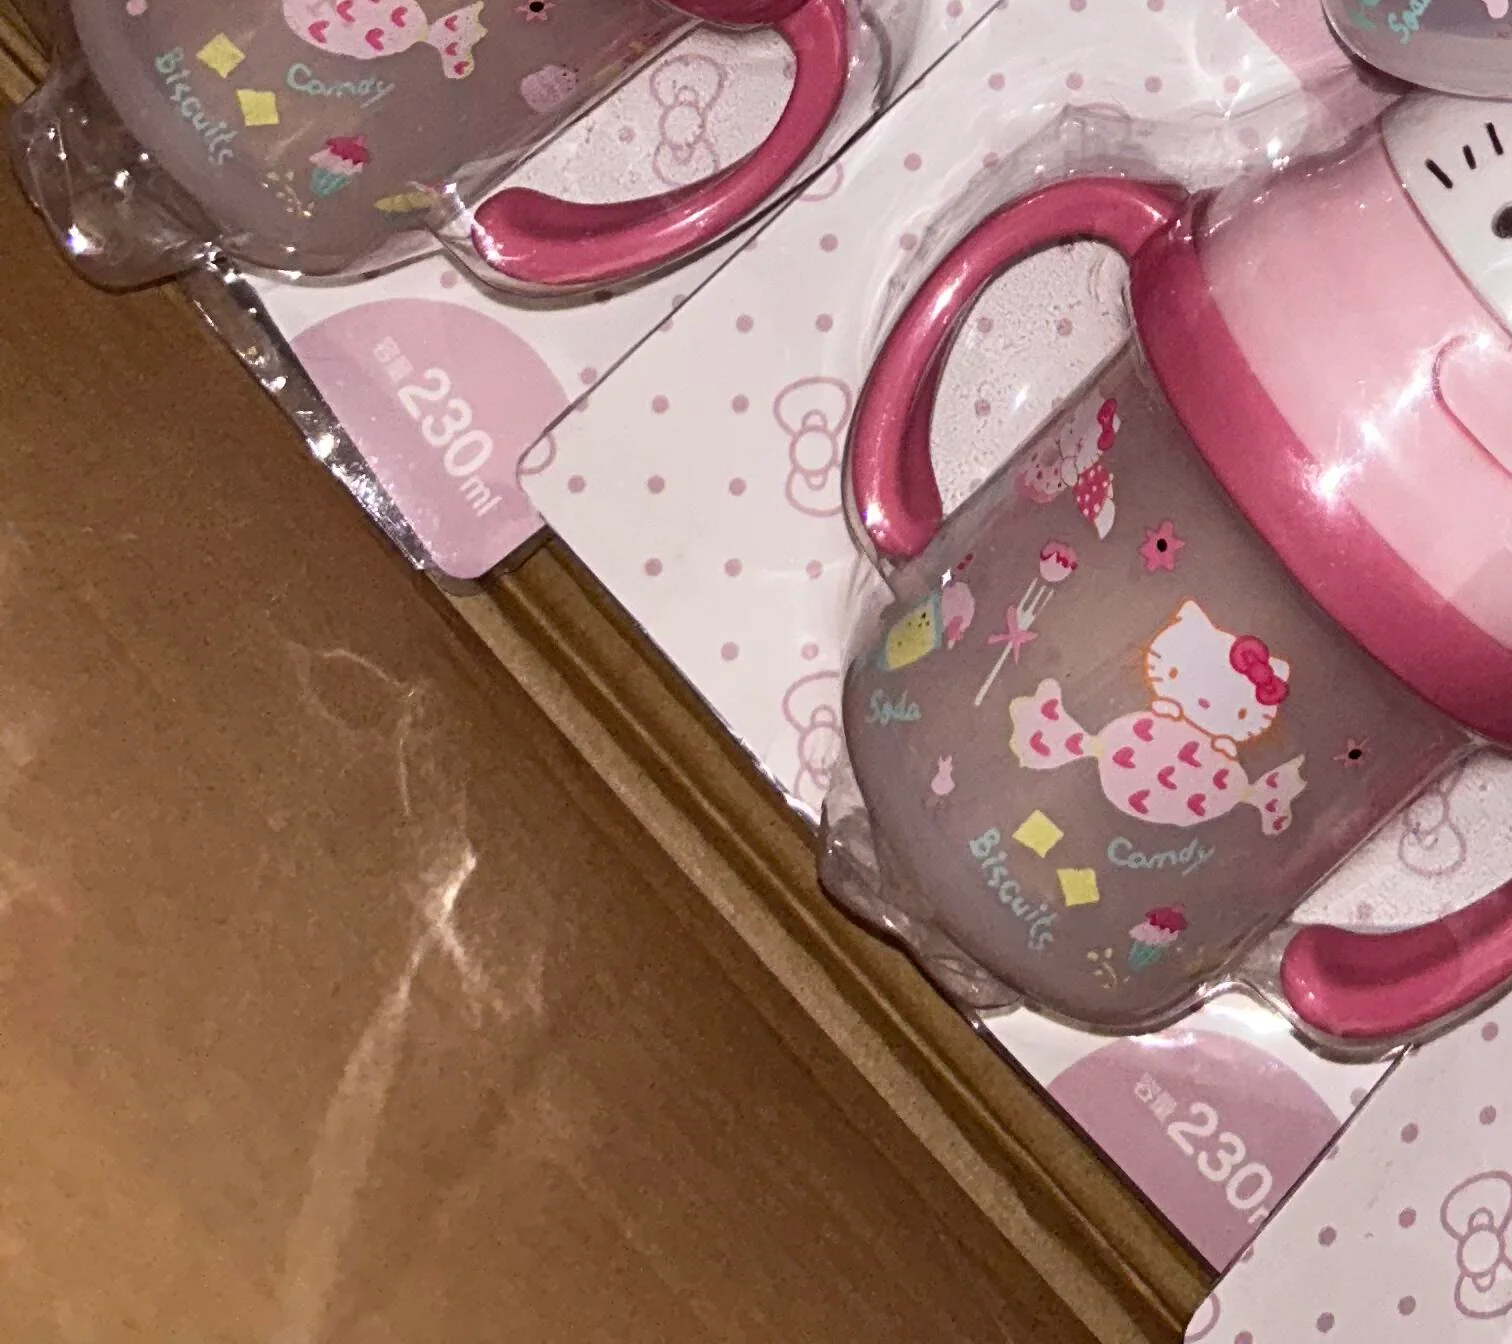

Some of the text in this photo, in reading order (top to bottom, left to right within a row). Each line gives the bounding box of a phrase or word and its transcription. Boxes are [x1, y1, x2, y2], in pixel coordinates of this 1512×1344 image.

[155, 46, 239, 166] Biscuits
[286, 62, 395, 109] Candy
[968, 828, 1059, 951] Biscuits
[1107, 836, 1215, 878] Candy
